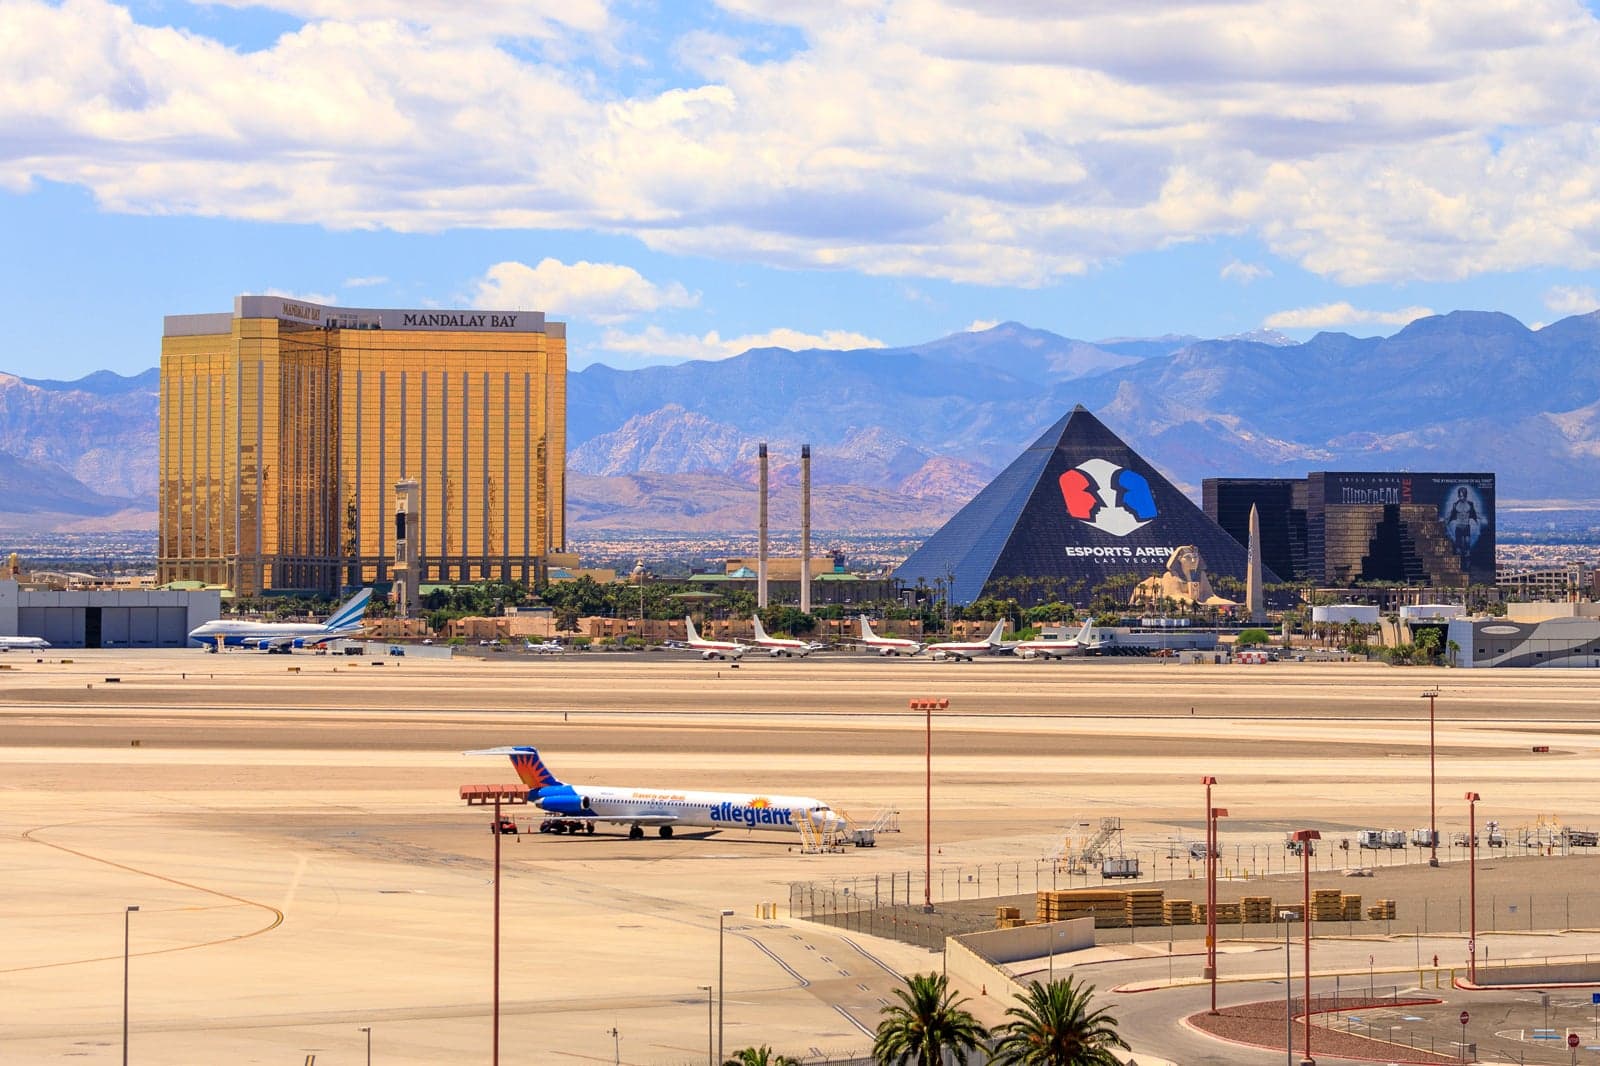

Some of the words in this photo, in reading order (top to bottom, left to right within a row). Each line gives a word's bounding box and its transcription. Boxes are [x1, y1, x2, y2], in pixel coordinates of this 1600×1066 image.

[403, 314, 486, 327] MANDALAY
[491, 315, 517, 327] BAY
[1065, 546, 1132, 556] ESPORTS
[1135, 546, 1174, 556] AREN
[710, 801, 793, 827] allegiant
